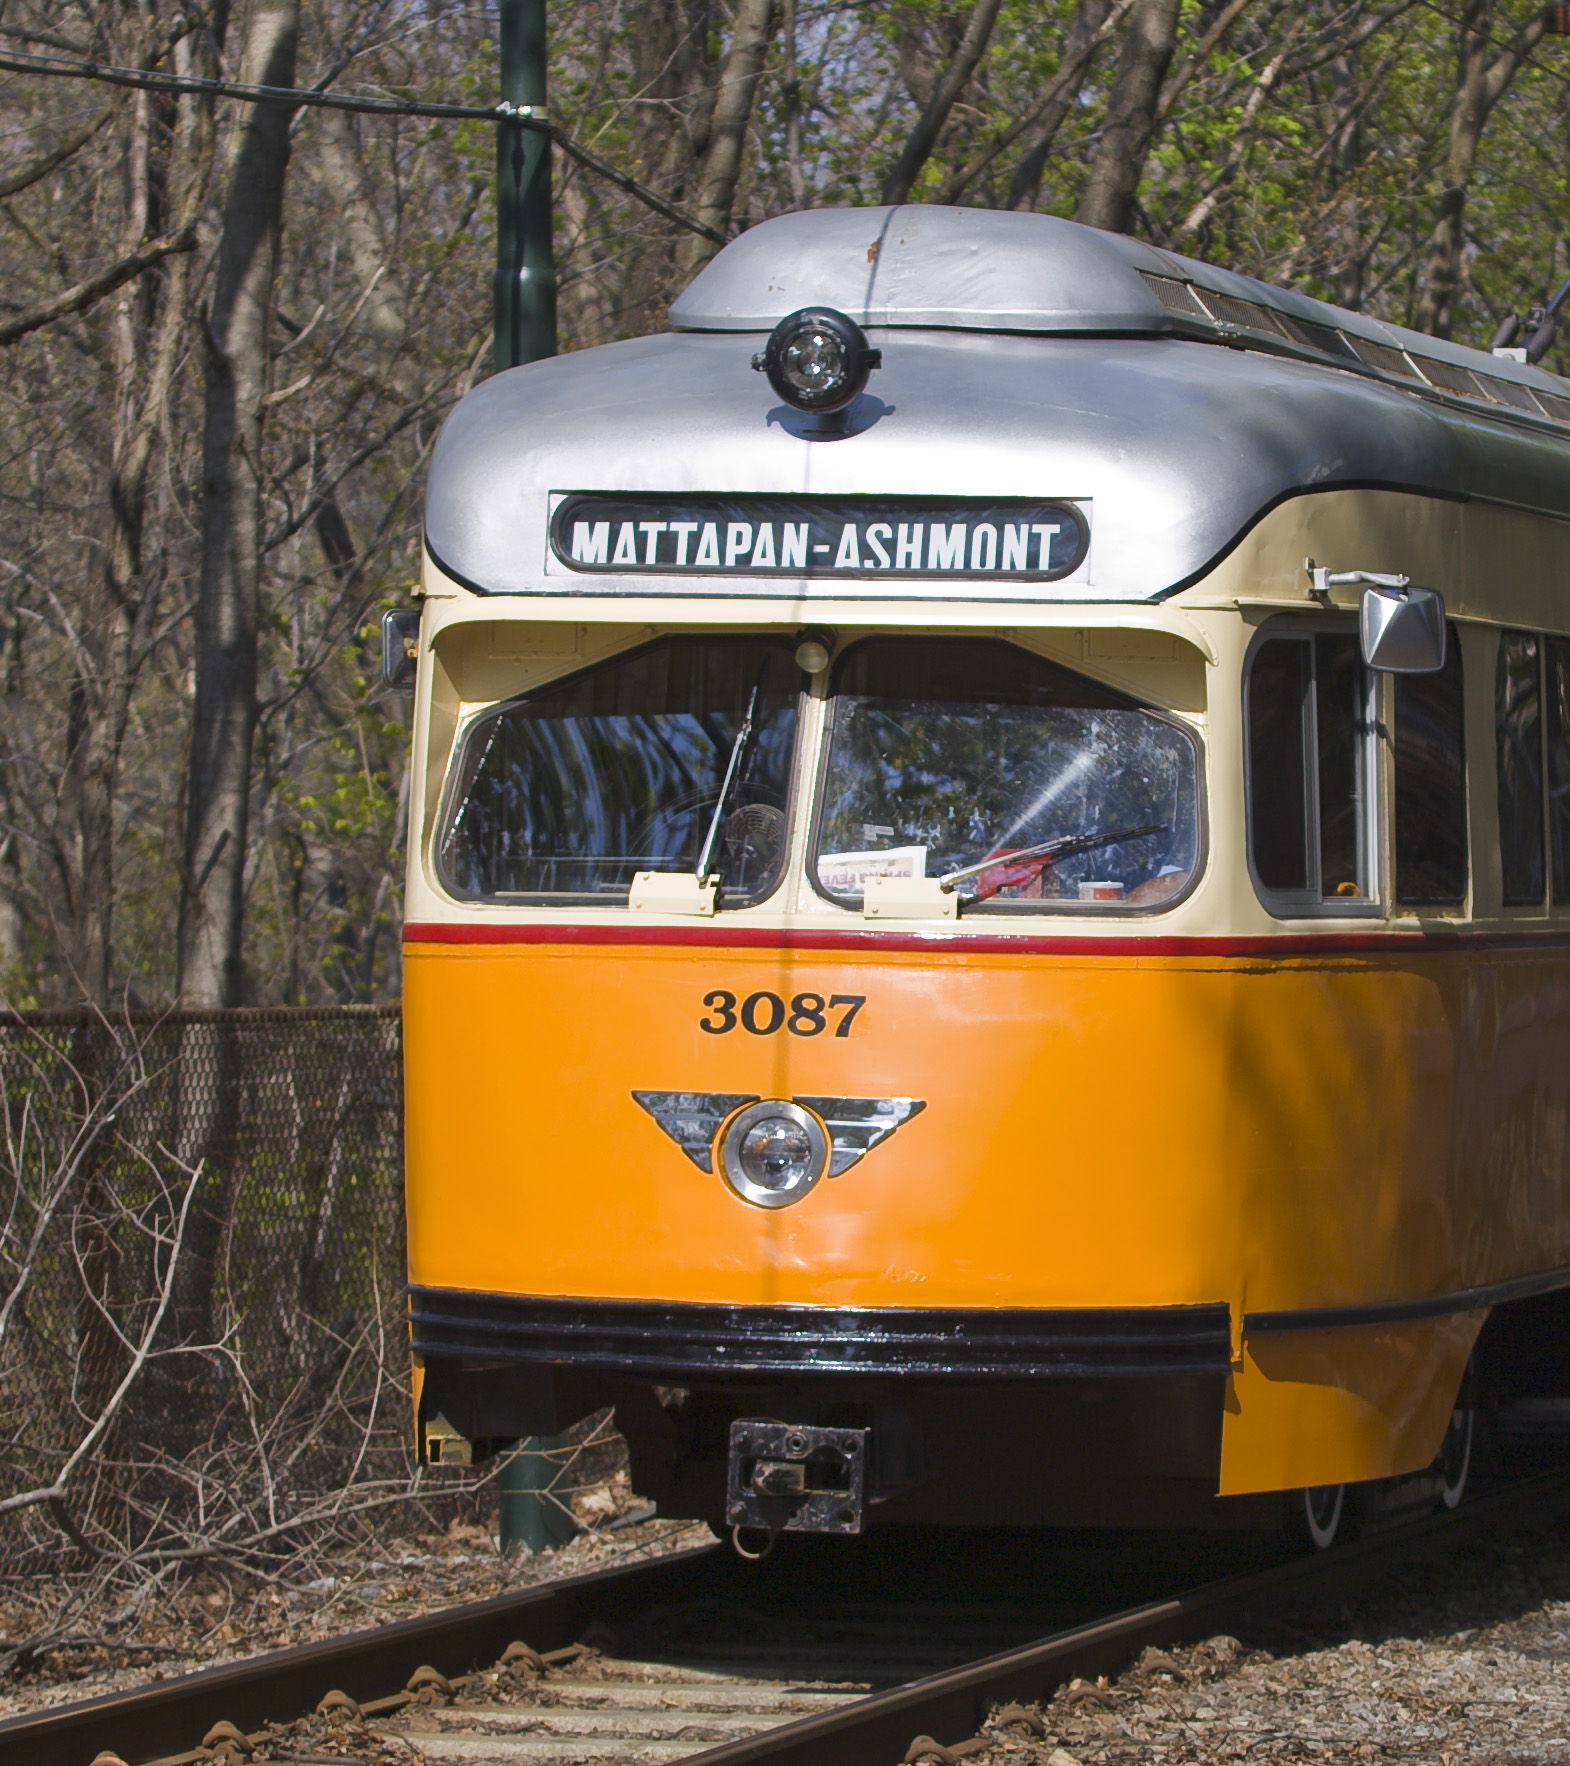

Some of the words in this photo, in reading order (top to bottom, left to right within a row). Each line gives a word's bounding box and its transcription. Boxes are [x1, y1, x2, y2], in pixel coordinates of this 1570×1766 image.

[572, 521, 1060, 570] MATTAPAN-ASHMONT
[820, 873, 857, 885] FEVE
[700, 990, 867, 1037] 3087
